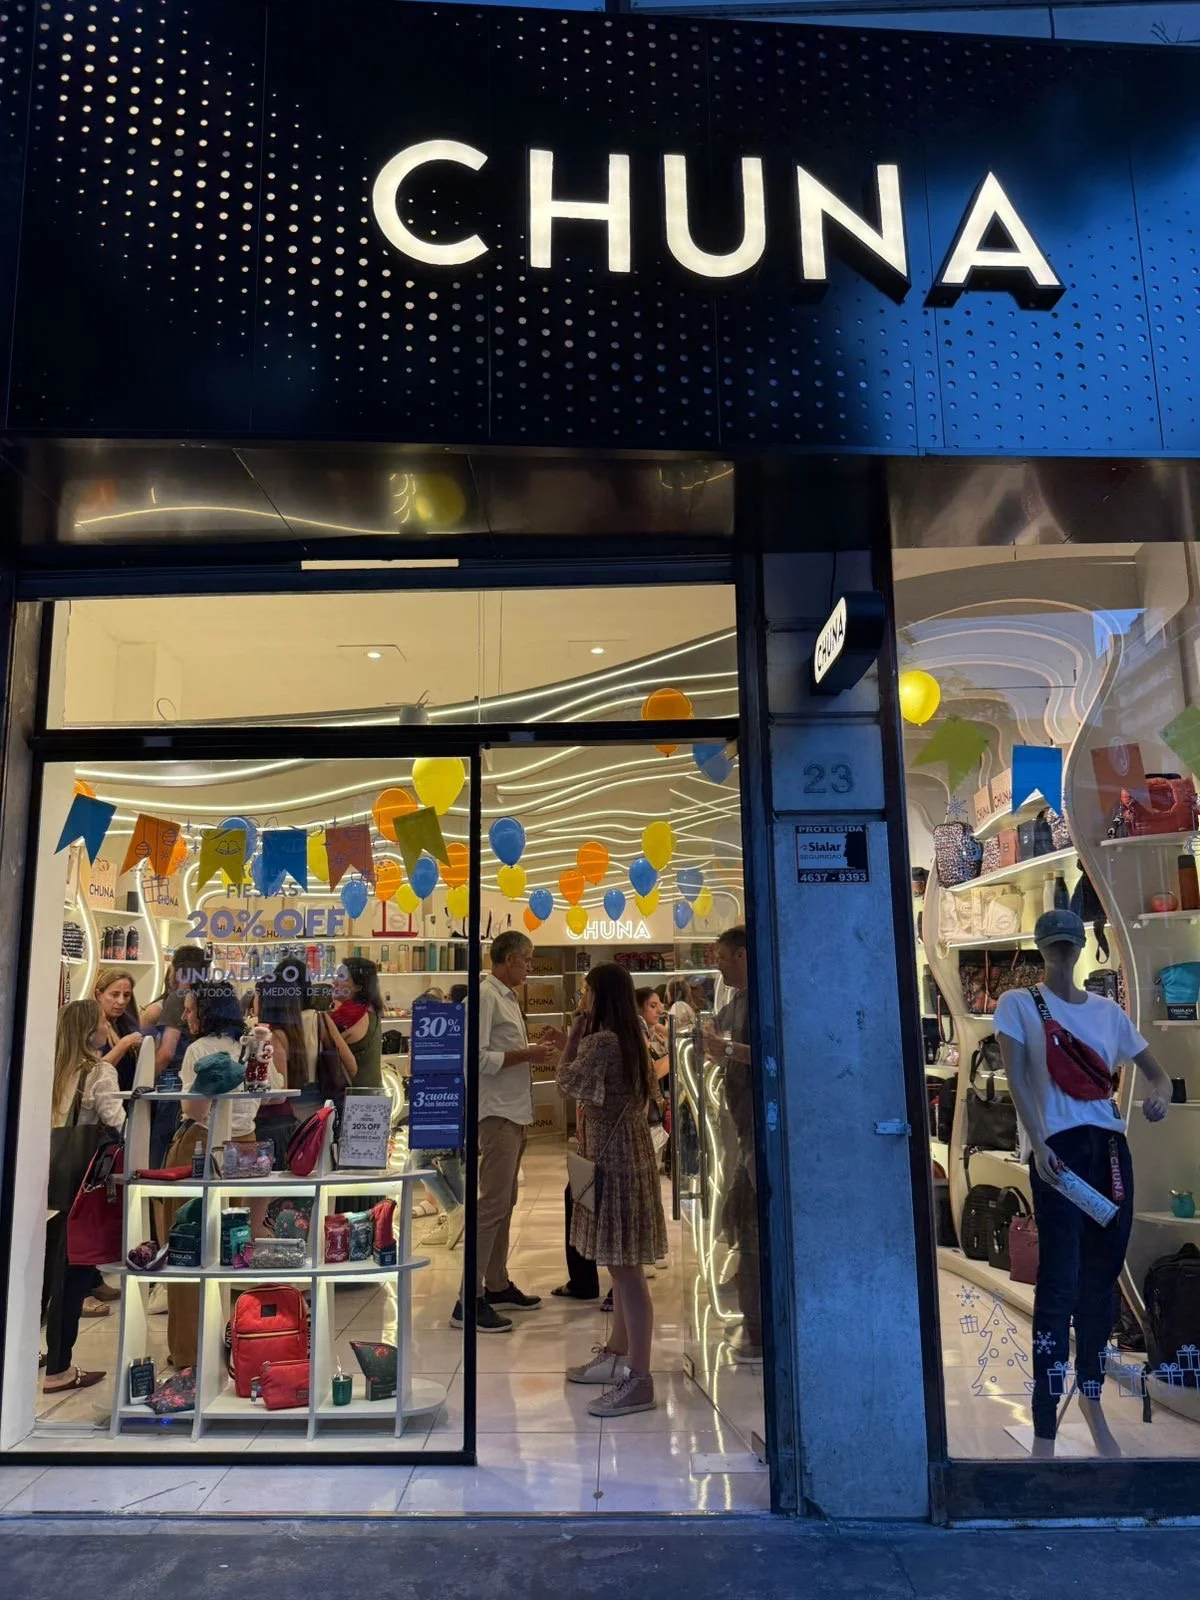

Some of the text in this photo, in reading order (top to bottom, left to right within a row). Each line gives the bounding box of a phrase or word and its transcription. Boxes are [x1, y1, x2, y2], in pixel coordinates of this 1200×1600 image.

[372, 139, 1062, 287] CHUNA
[817, 612, 844, 672] CHUNA
[803, 763, 853, 794] 23
[798, 825, 863, 833] PROTEGIDA
[808, 842, 841, 852] Sialar
[800, 873, 828, 882] 4637
[838, 872, 867, 882] 9393
[89, 883, 115, 899] CHUNA
[185, 909, 266, 939] 20%
[273, 908, 346, 938] OFF
[176, 967, 276, 984] UNIDADES
[282, 965, 299, 983] O
[177, 988, 200, 998] CON
[203, 988, 237, 998] TODOS
[262, 987, 302, 997] MEDIOS
[306, 988, 320, 997] DE
[322, 987, 351, 997] PAGO
[415, 1016, 461, 1038] 30%
[413, 1091, 459, 1107] 3 cuotas
[367, 1122, 381, 1130] OFF
[1110, 1156, 1124, 1198] CHUNA
